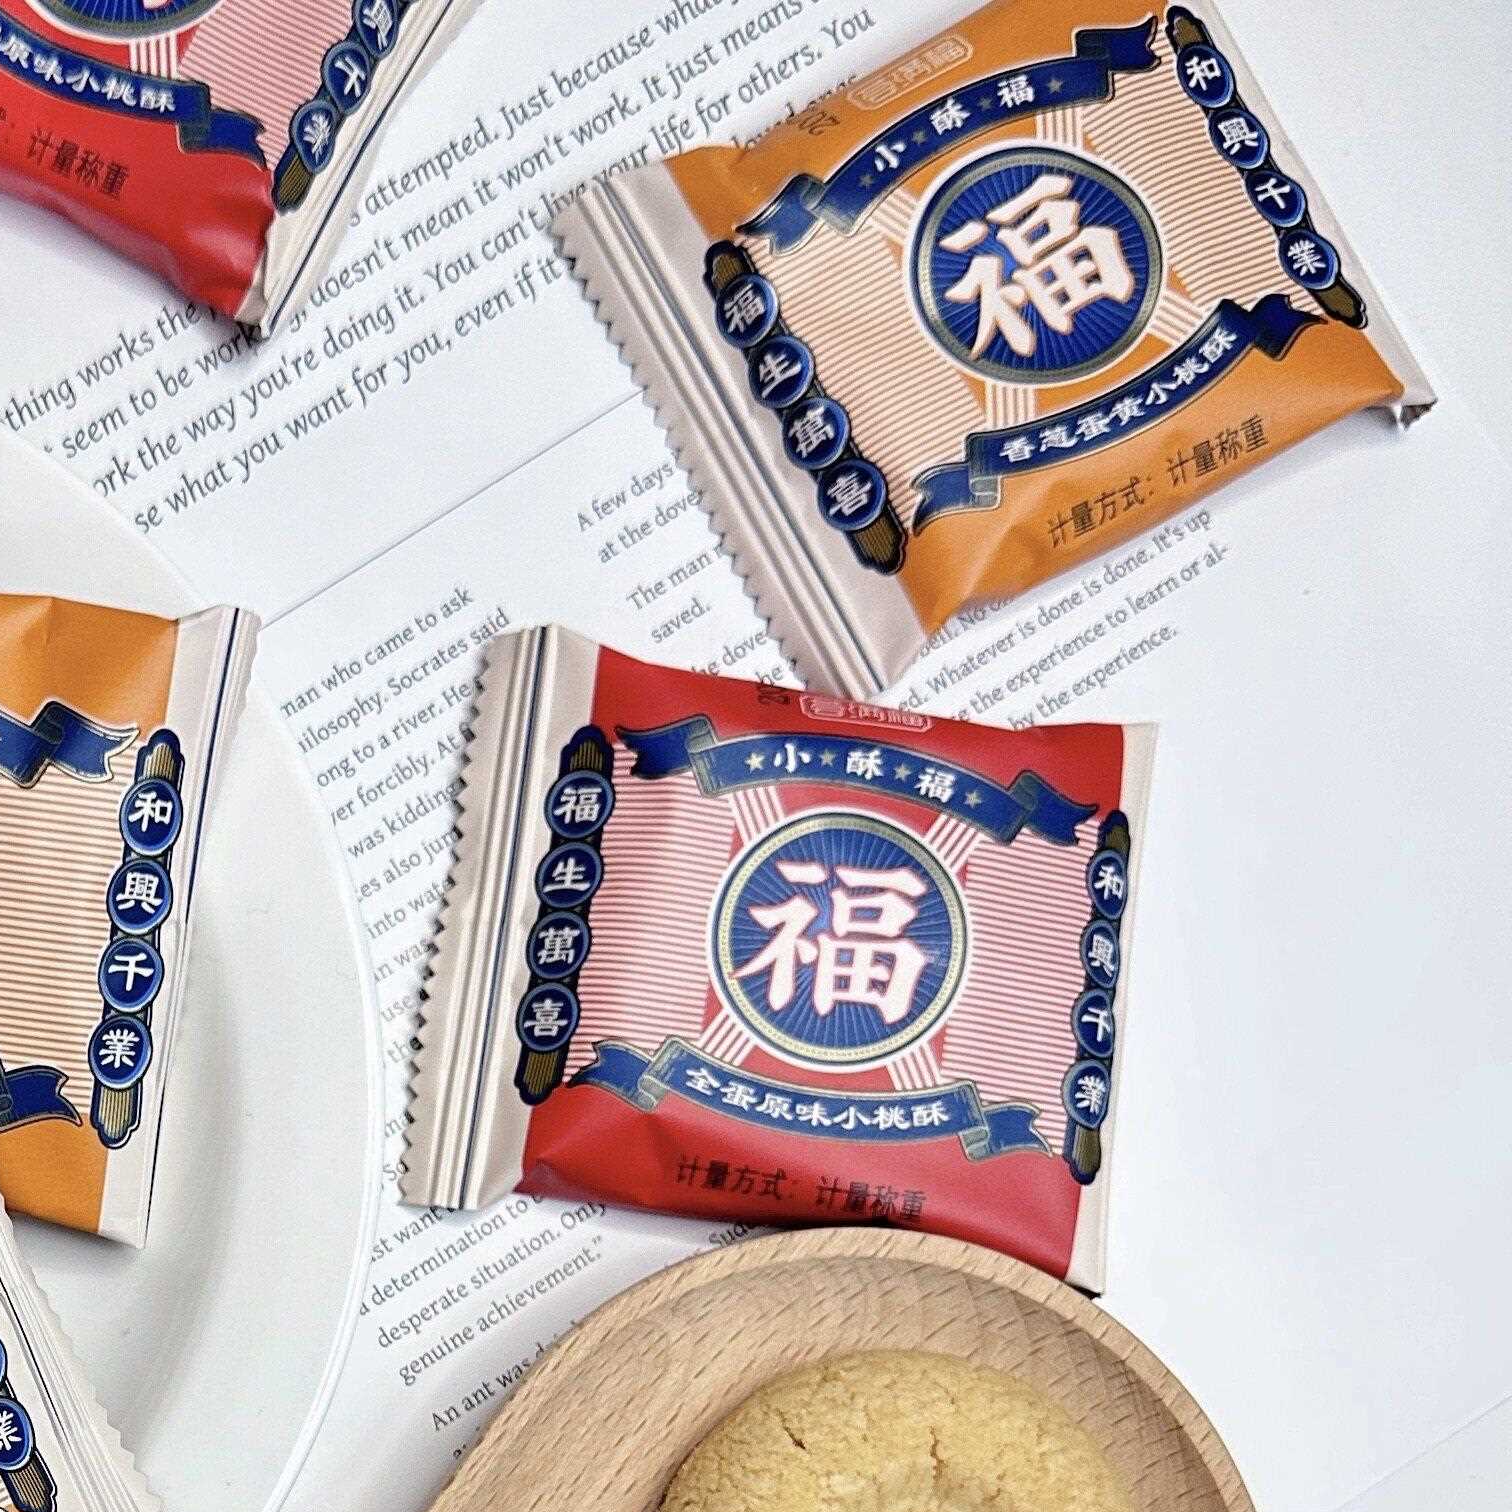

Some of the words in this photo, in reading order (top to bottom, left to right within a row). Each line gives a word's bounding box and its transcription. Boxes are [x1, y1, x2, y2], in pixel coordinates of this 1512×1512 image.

[875, 75, 1036, 172] 小酥福
[1185, 56, 1329, 275] 和興千業
[61, 406, 128, 459] seem
[128, 387, 158, 417] to
[154, 365, 195, 398] be
[399, 195, 475, 253] mean
[472, 177, 498, 207] it
[496, 133, 571, 191] won't
[568, 89, 643, 147] work.
[640, 75, 668, 105] It
[665, 41, 721, 102] just
[719, 0, 805, 57] means
[75, 329, 155, 388] works
[155, 301, 201, 342] the
[365, 115, 500, 215] attempted.
[498, 84, 555, 141] Just
[549, 24, 656, 98] because
[136, 431, 183, 473] the
[182, 396, 237, 443] way
[239, 347, 321, 420] you're
[322, 302, 396, 359] doing
[393, 284, 426, 314] it.
[422, 251, 480, 293] You
[481, 206, 551, 262] can't
[647, 112, 695, 165] life
[694, 92, 731, 138] for
[737, 43, 823, 105] others.
[820, 8, 877, 50] You
[940, 173, 1134, 357] 福
[163, 460, 233, 514] what
[231, 431, 285, 484] you
[283, 386, 353, 441] want
[351, 361, 388, 409] for
[393, 331, 453, 385] you,
[454, 287, 515, 338] even
[513, 259, 537, 304] if
[726, 290, 872, 518] 福生萬喜
[998, 327, 1239, 466] 香葱蛋黄小桃酥
[577, 511, 595, 533] A
[591, 489, 627, 521] few
[630, 462, 675, 498] days
[597, 540, 620, 564] at
[617, 520, 654, 550] the
[625, 580, 668, 611] The
[666, 551, 714, 588] man
[650, 596, 712, 644] saved.
[925, 630, 1016, 695] Whatever
[1015, 620, 1037, 640] is
[1037, 590, 1085, 628] done
[1081, 578, 1103, 598] is
[1102, 548, 1156, 586] done.
[1151, 524, 1186, 554] It's
[1183, 508, 1213, 533] up
[320, 660, 363, 692] who
[364, 625, 416, 666] came
[413, 612, 439, 634] to
[439, 586, 474, 619] ask
[386, 638, 469, 697] Socrates
[469, 606, 511, 645] said
[969, 686, 1006, 715] the
[1005, 622, 1107, 694] experience
[1103, 608, 1129, 629] to
[1123, 575, 1181, 616] learn
[1179, 558, 1201, 582] or
[1035, 690, 1074, 718] the
[1071, 625, 1179, 697] experience.
[351, 743, 376, 764] to
[377, 733, 392, 750] a
[391, 702, 445, 741] river.
[440, 683, 473, 709] He
[356, 753, 436, 808] forcibly.
[436, 733, 461, 760] At
[774, 744, 956, 803] 小酥福
[347, 829, 385, 859] was
[382, 852, 423, 885] also
[97, 790, 174, 1070] 和興千業
[362, 907, 407, 940] into
[524, 785, 601, 1036] 福生萬喜
[734, 861, 933, 1023] 福
[685, 1067, 950, 1130] 全蛋原味小桃酥
[373, 1215, 508, 1306] determination
[505, 1192, 529, 1220] to
[377, 1283, 470, 1349] desperate
[470, 1228, 561, 1290] situation.
[398, 1326, 475, 1387] genuine
[431, 1405, 462, 1432] An
[461, 1381, 496, 1412] ant
